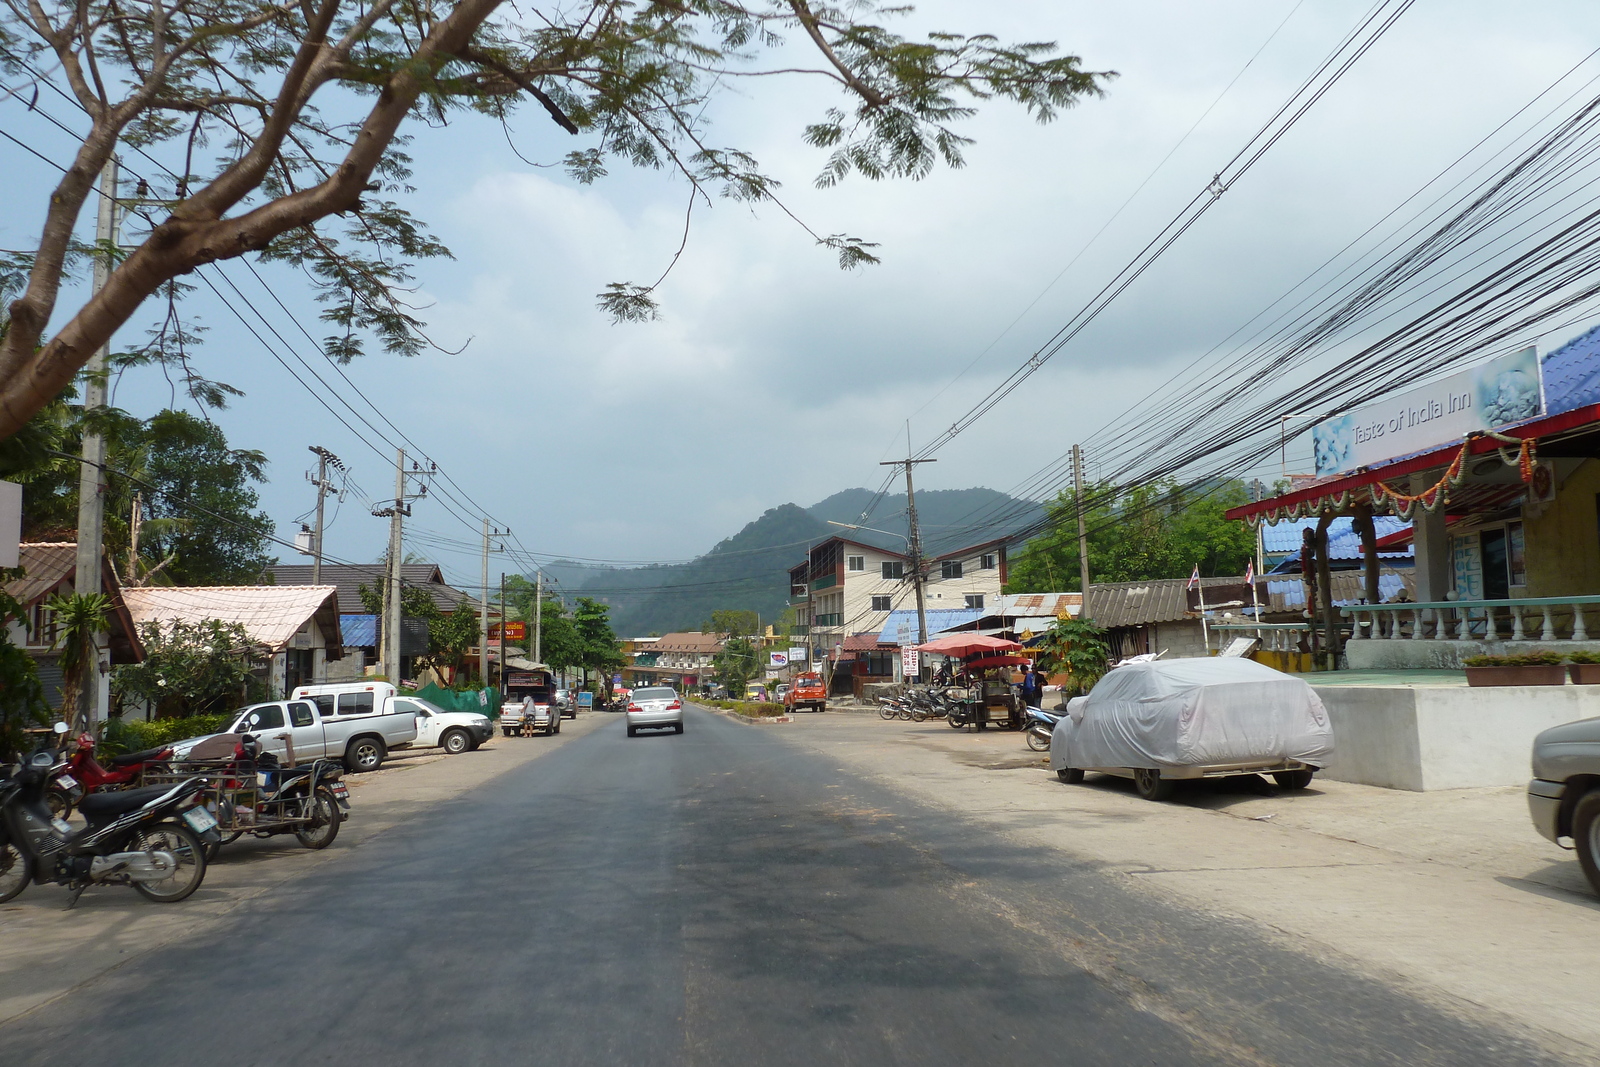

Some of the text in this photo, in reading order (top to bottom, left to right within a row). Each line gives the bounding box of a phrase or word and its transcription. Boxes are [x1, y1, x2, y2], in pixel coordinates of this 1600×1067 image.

[1352, 392, 1471, 445] Taste of India Inn
